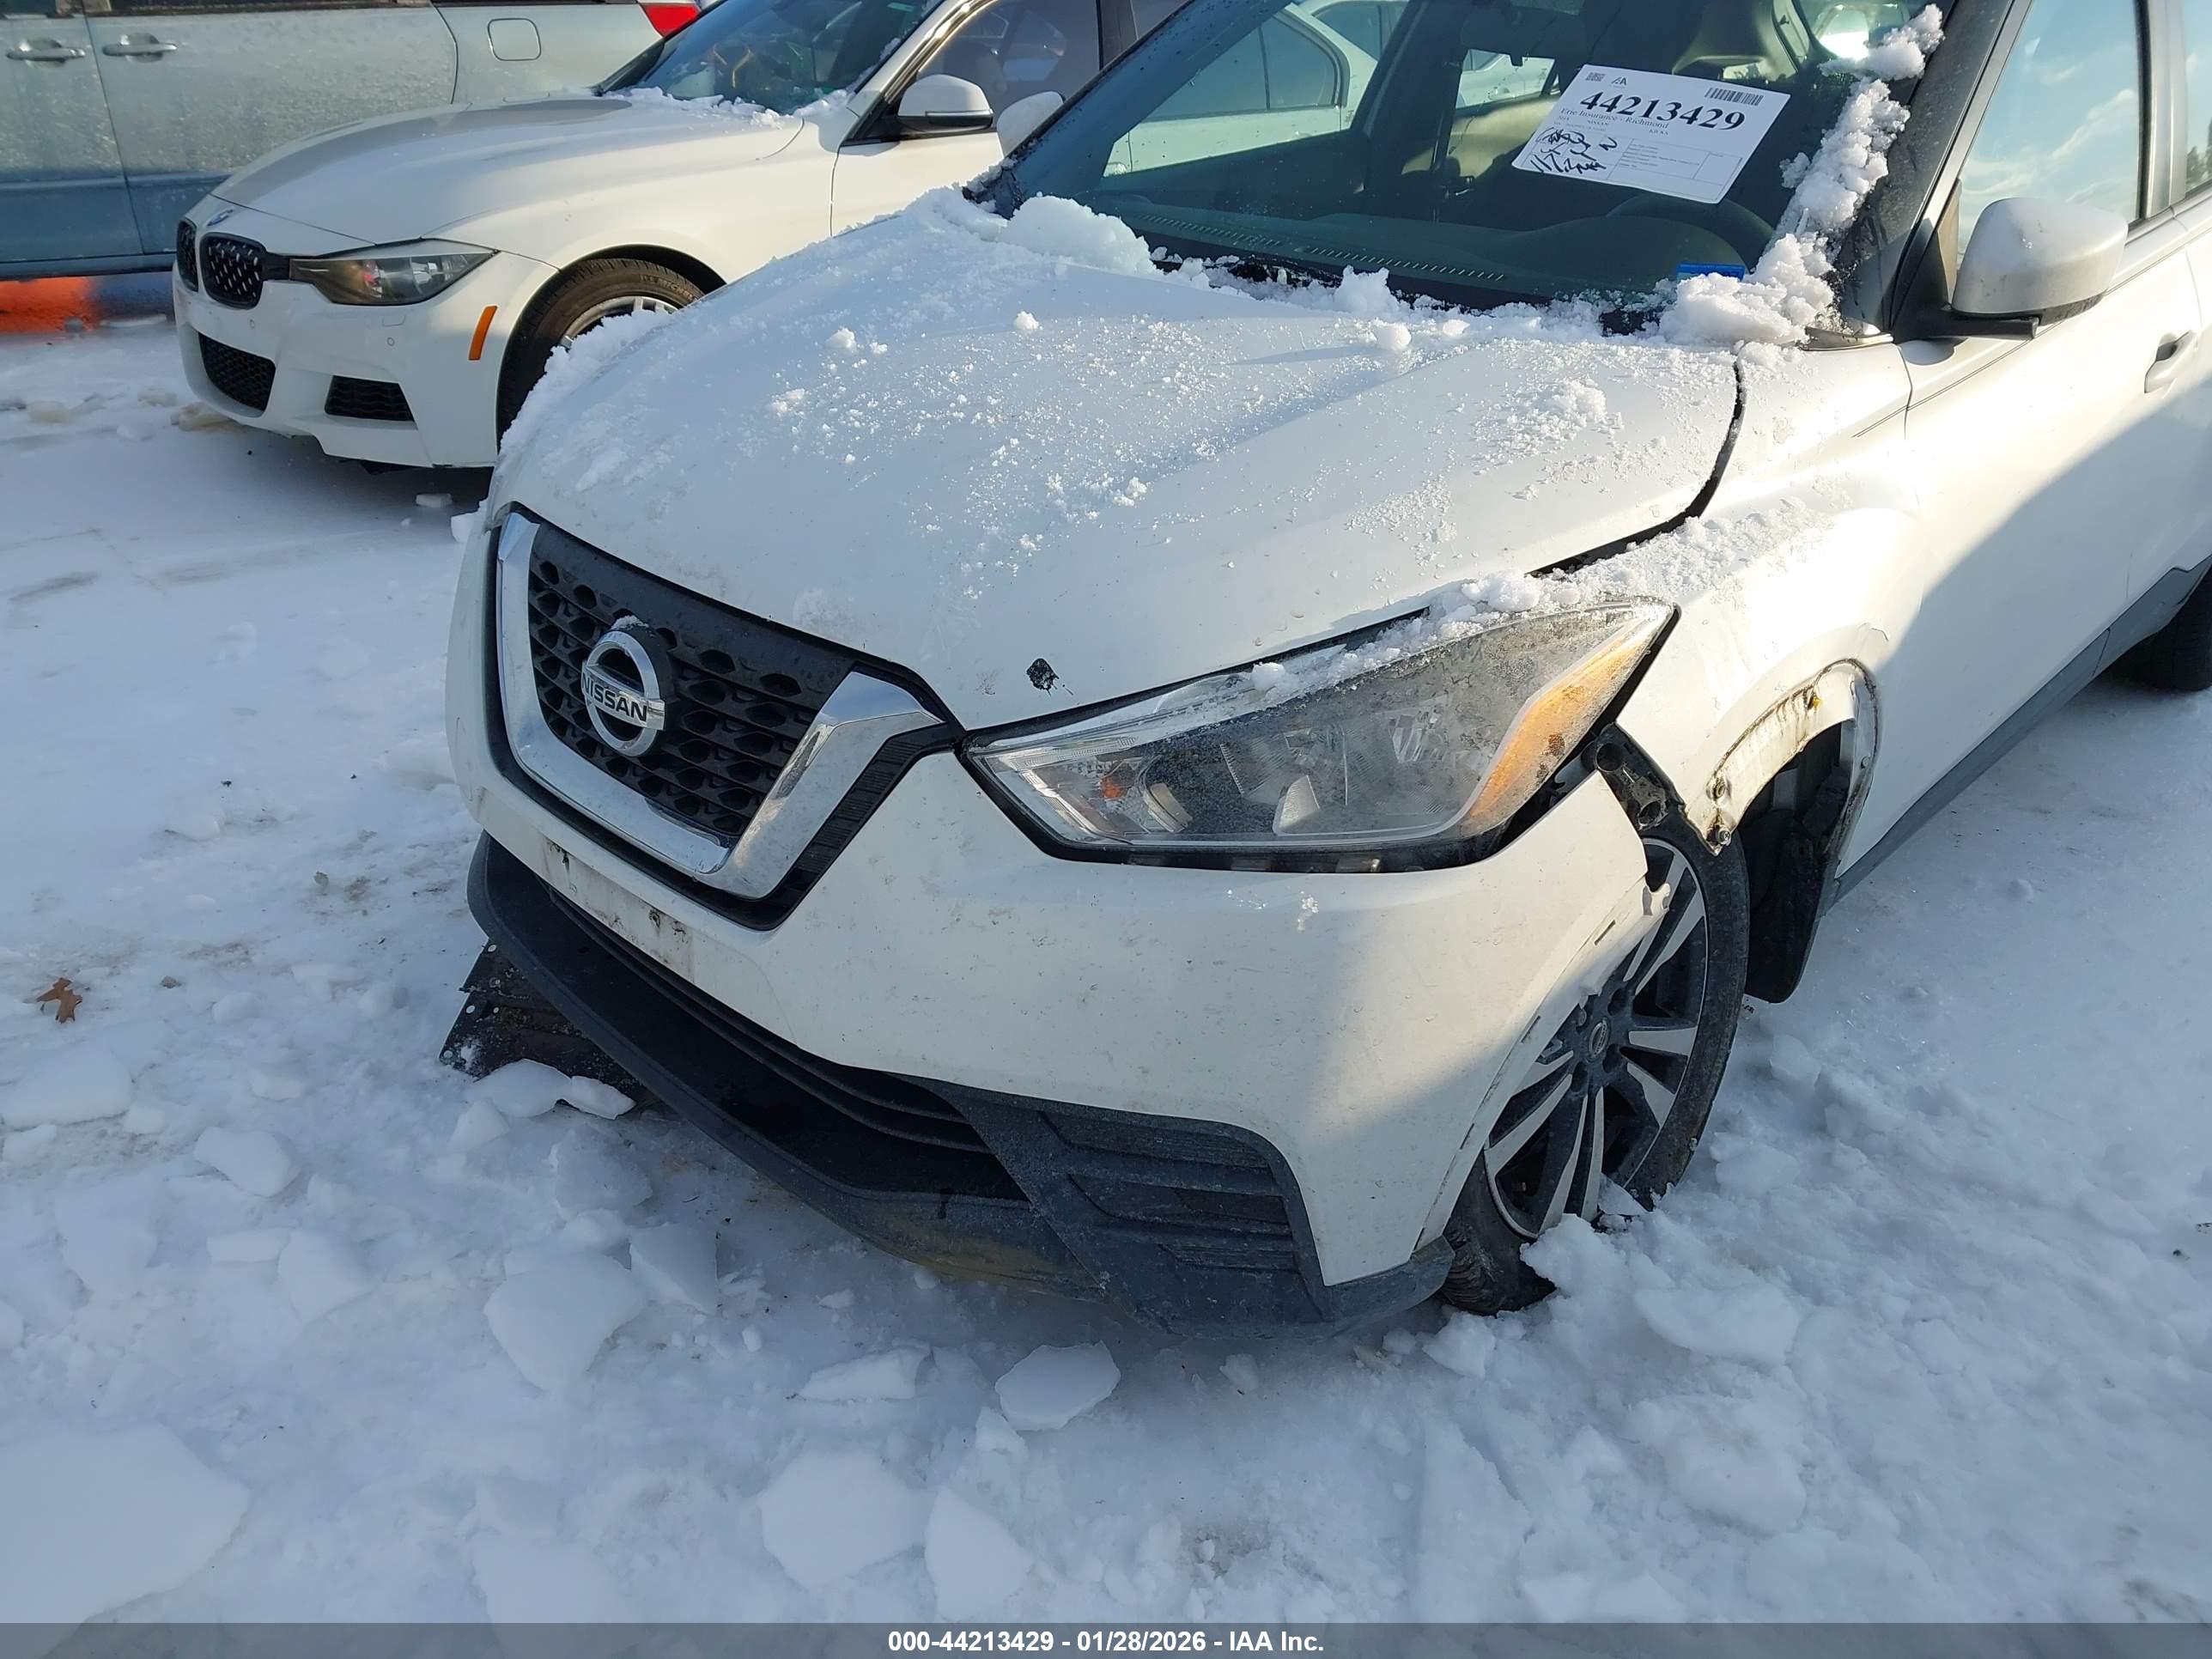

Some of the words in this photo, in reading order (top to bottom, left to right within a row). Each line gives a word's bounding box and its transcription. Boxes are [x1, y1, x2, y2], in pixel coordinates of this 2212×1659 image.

[1579, 91, 1746, 130] 44213429
[1625, 117, 1669, 129] Richmond
[581, 672, 647, 722] NISSAN
